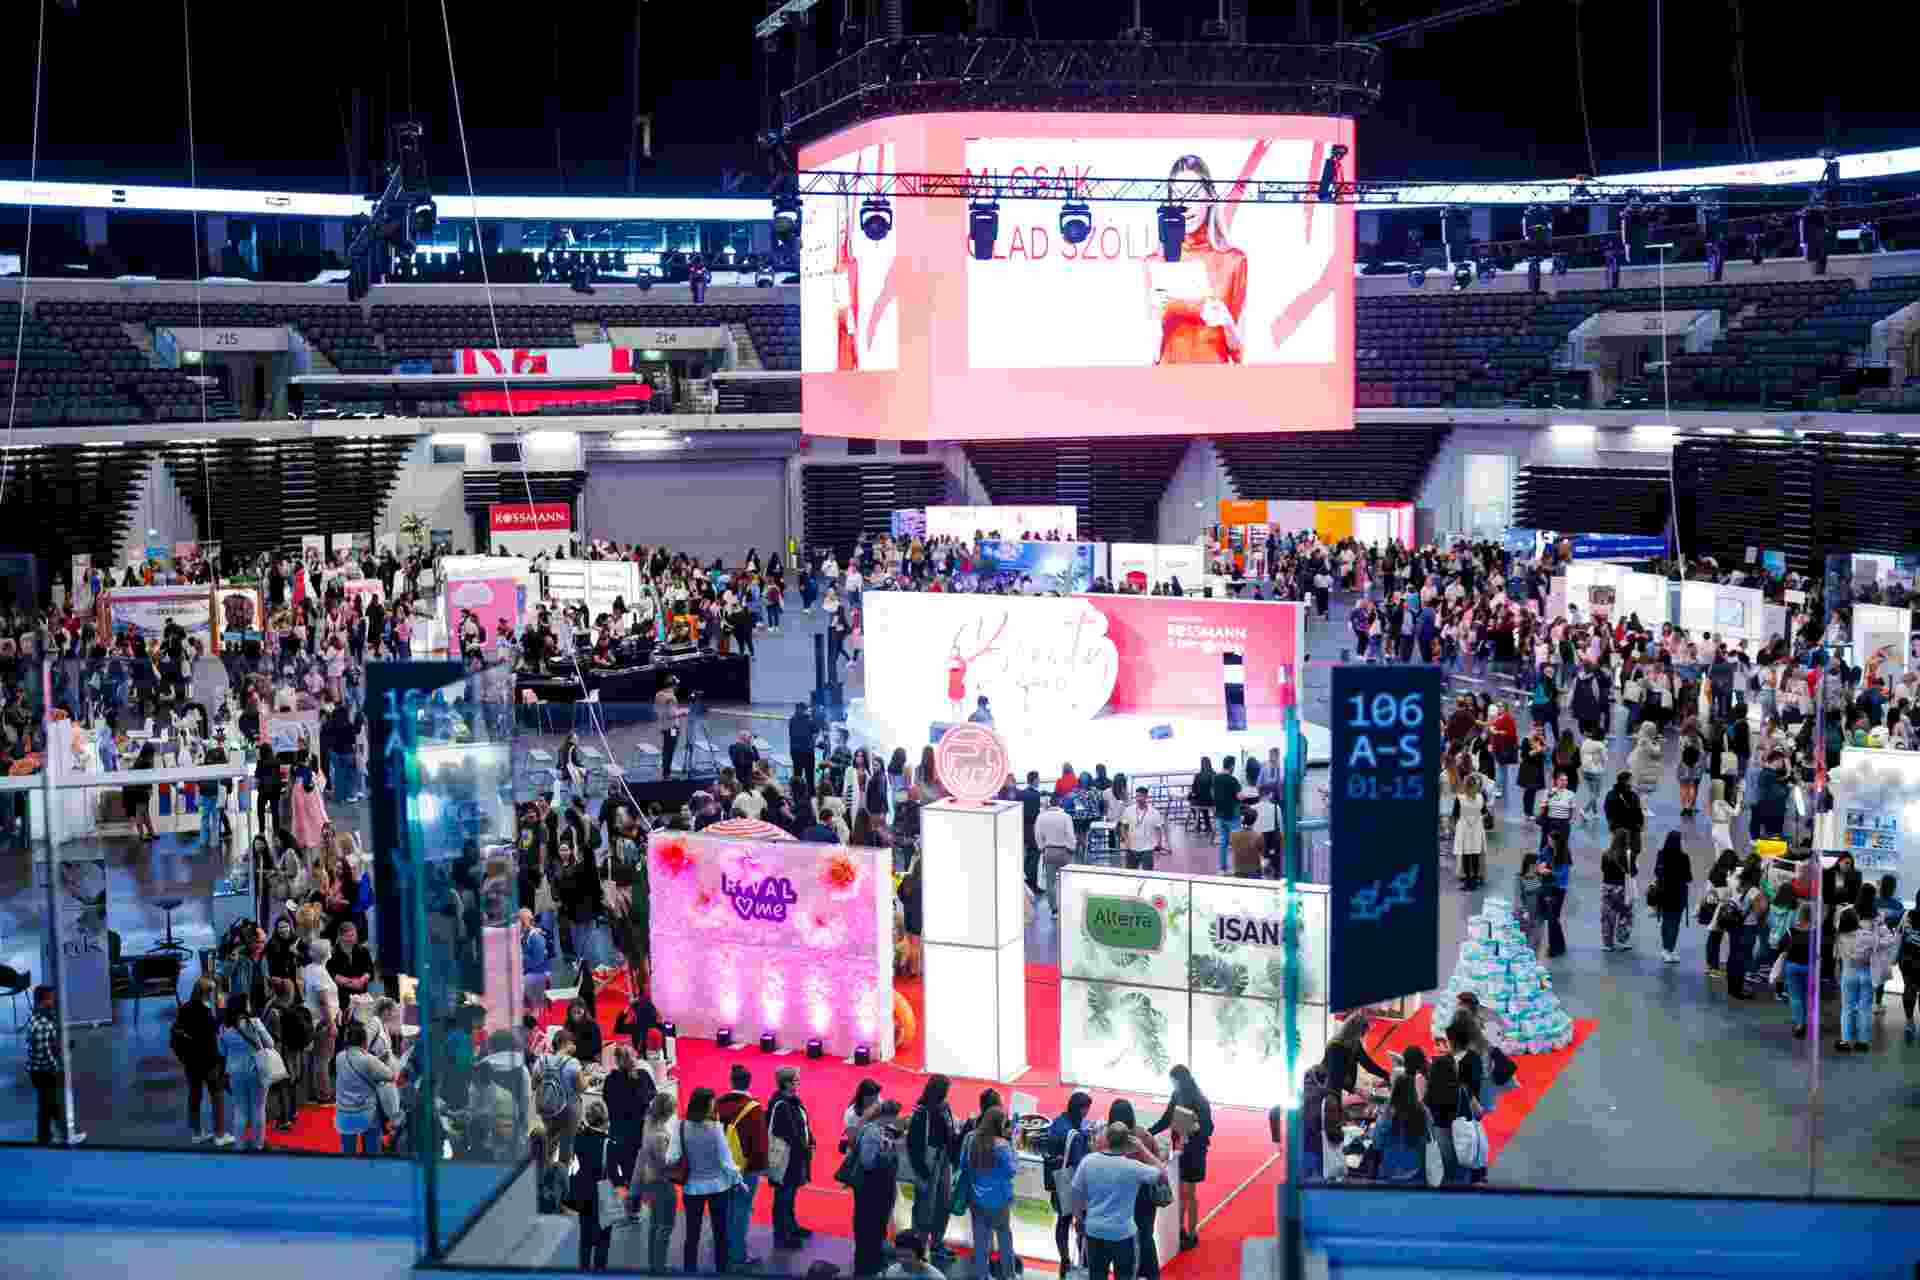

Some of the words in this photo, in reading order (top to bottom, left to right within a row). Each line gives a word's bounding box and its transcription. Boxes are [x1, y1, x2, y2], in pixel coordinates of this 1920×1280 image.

[1348, 692, 1424, 728] 106
[1349, 734, 1423, 768] A-S
[1347, 773, 1424, 800] 01-15
[1093, 909, 1152, 929] Alterra
